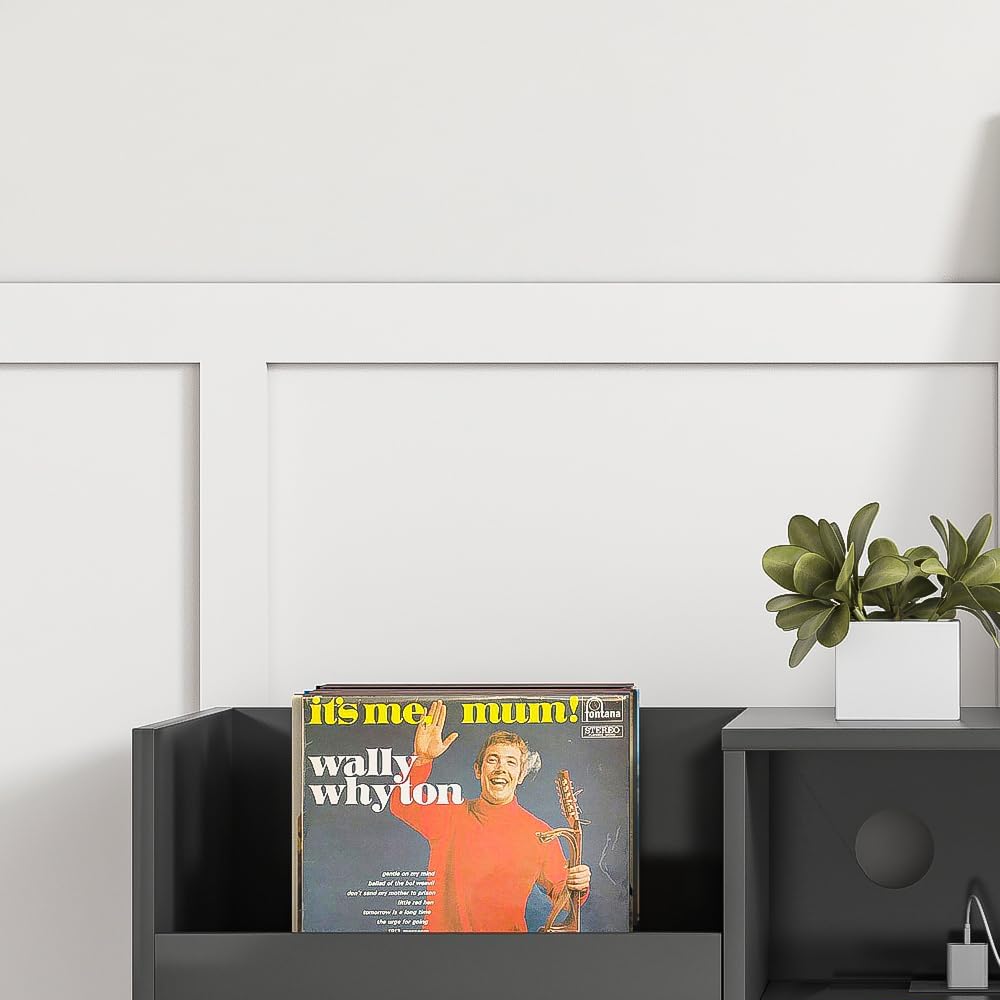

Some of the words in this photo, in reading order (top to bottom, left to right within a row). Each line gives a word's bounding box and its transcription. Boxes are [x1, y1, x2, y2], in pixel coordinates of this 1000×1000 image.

[308, 697, 359, 725] it's
[461, 696, 578, 724] mum!
[585, 726, 620, 734] STEREO
[308, 748, 419, 782] wally
[309, 777, 464, 812] whyton
